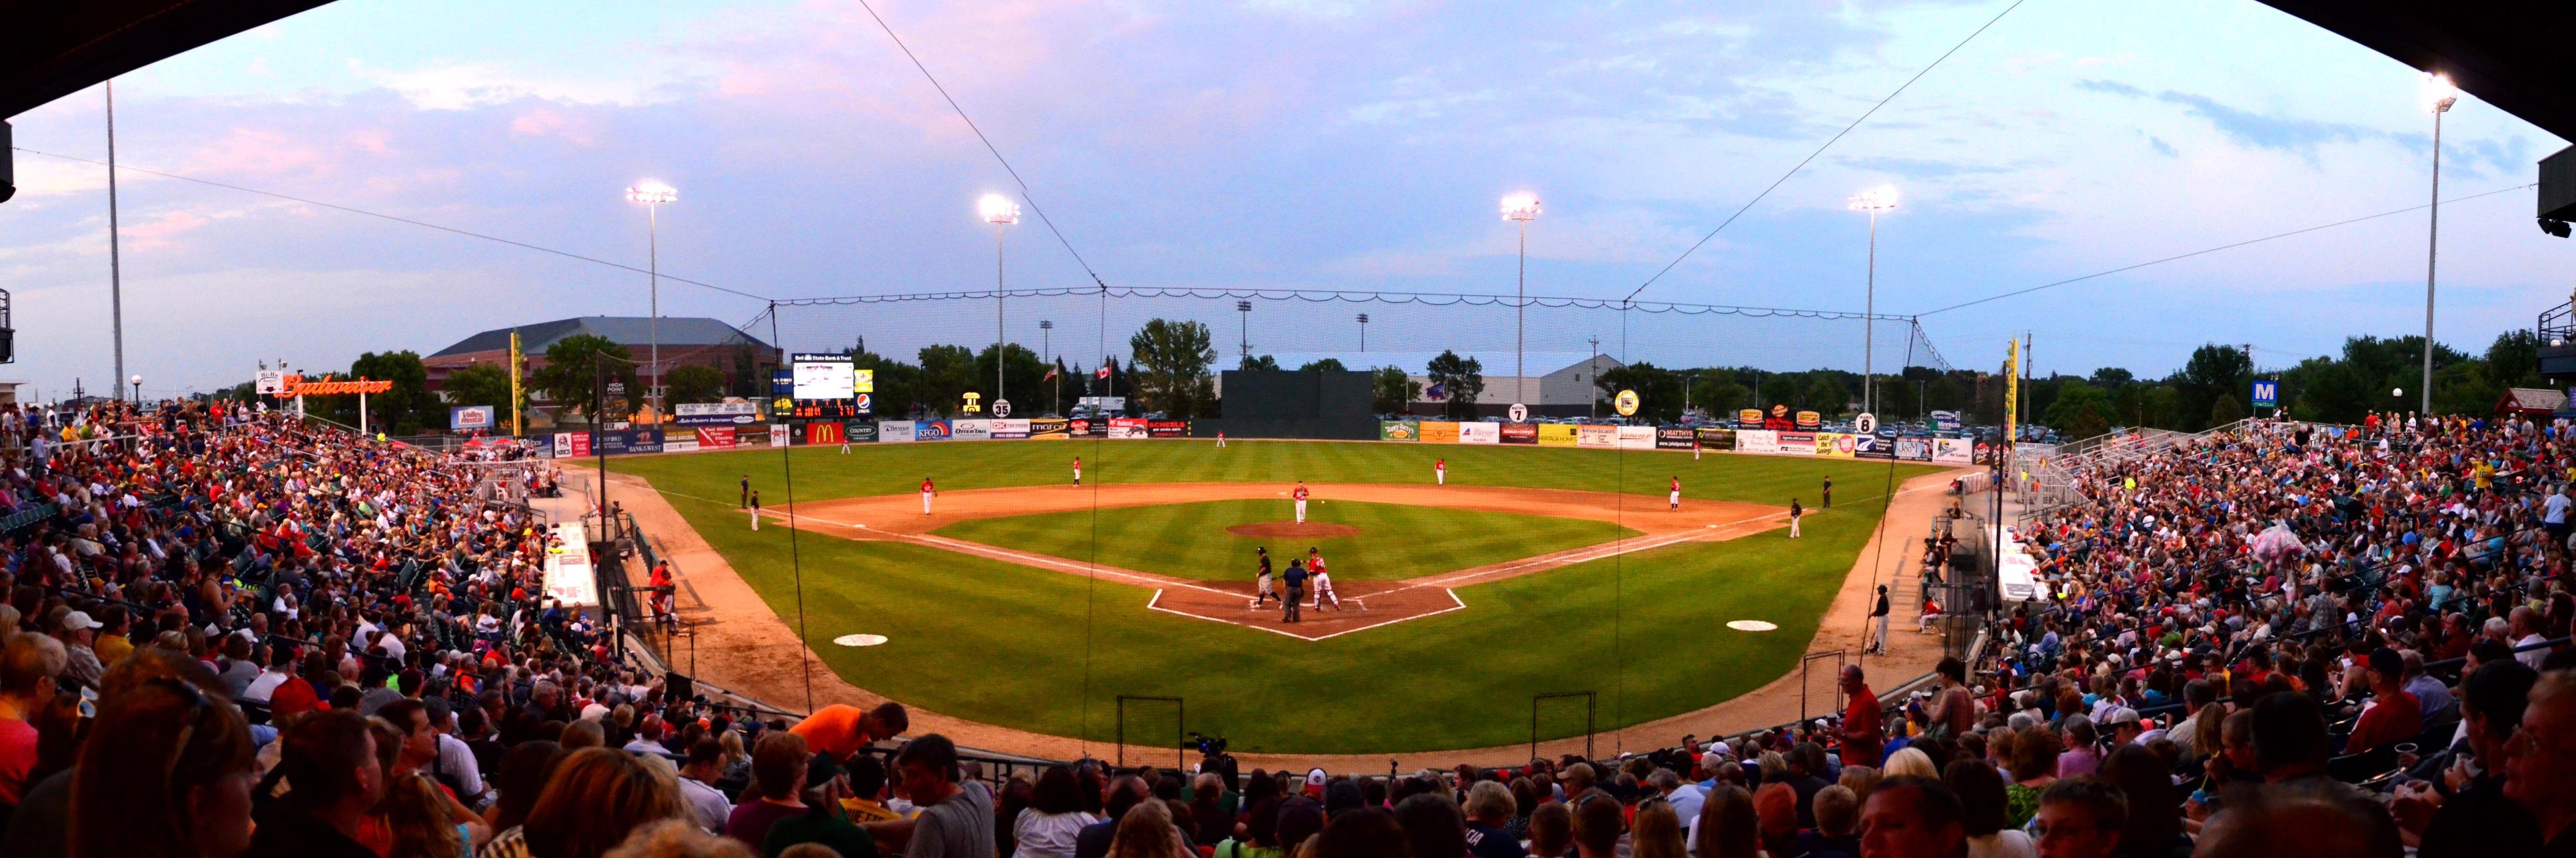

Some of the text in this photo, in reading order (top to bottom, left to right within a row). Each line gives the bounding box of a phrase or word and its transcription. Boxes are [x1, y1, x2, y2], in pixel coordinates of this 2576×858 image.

[274, 374, 393, 398] Budweiser
[2255, 384, 2274, 400] M
[995, 406, 1008, 415] 35
[1515, 410, 1521, 420] 7
[1861, 419, 1870, 432] 8
